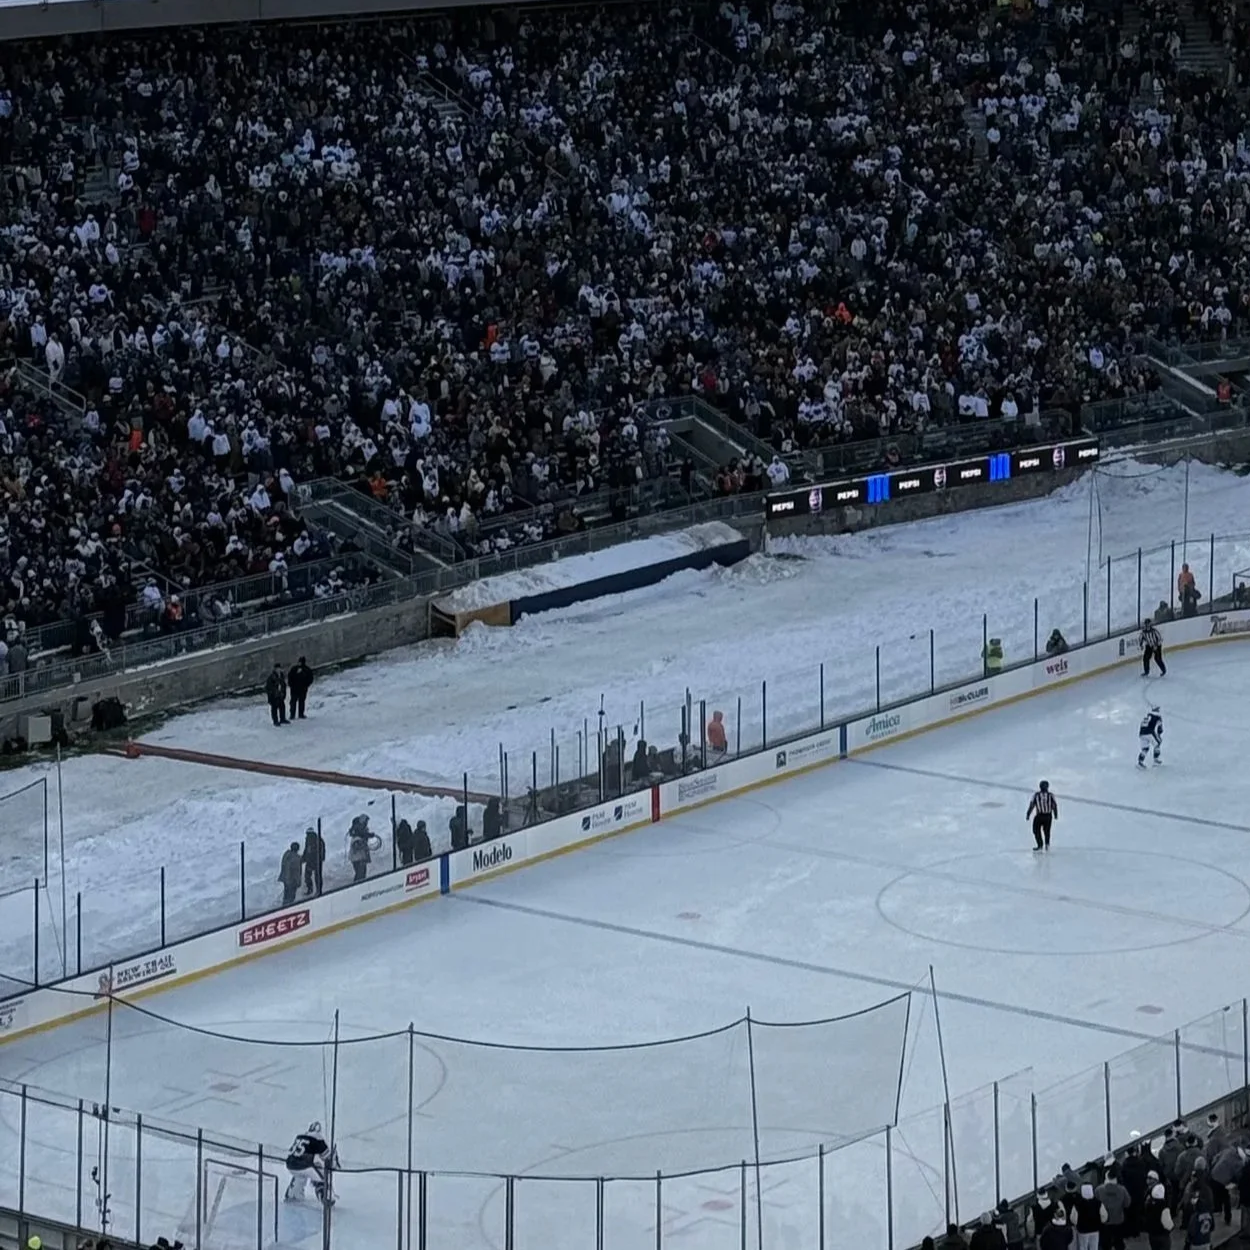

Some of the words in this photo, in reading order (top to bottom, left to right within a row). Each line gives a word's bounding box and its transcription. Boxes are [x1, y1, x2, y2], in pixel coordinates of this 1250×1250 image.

[866, 714, 901, 736] Amica
[473, 843, 513, 872] Modelo
[243, 912, 306, 944] SHEETZ
